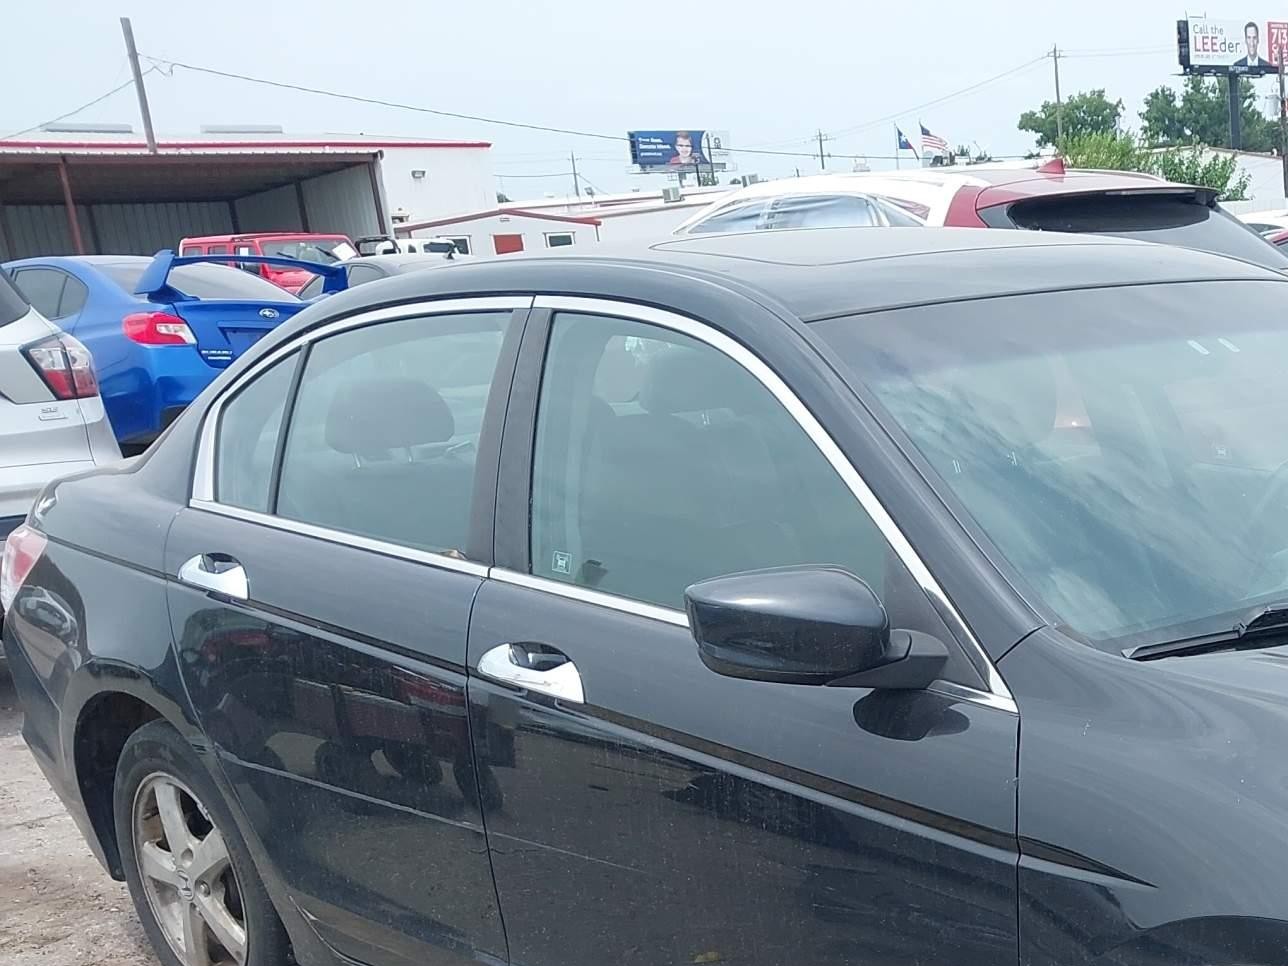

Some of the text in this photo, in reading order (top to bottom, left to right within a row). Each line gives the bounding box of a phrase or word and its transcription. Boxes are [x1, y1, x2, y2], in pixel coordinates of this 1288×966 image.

[1193, 23, 1224, 35] Call the
[1271, 28, 1288, 44] 713
[1194, 36, 1242, 53] LEEder.
